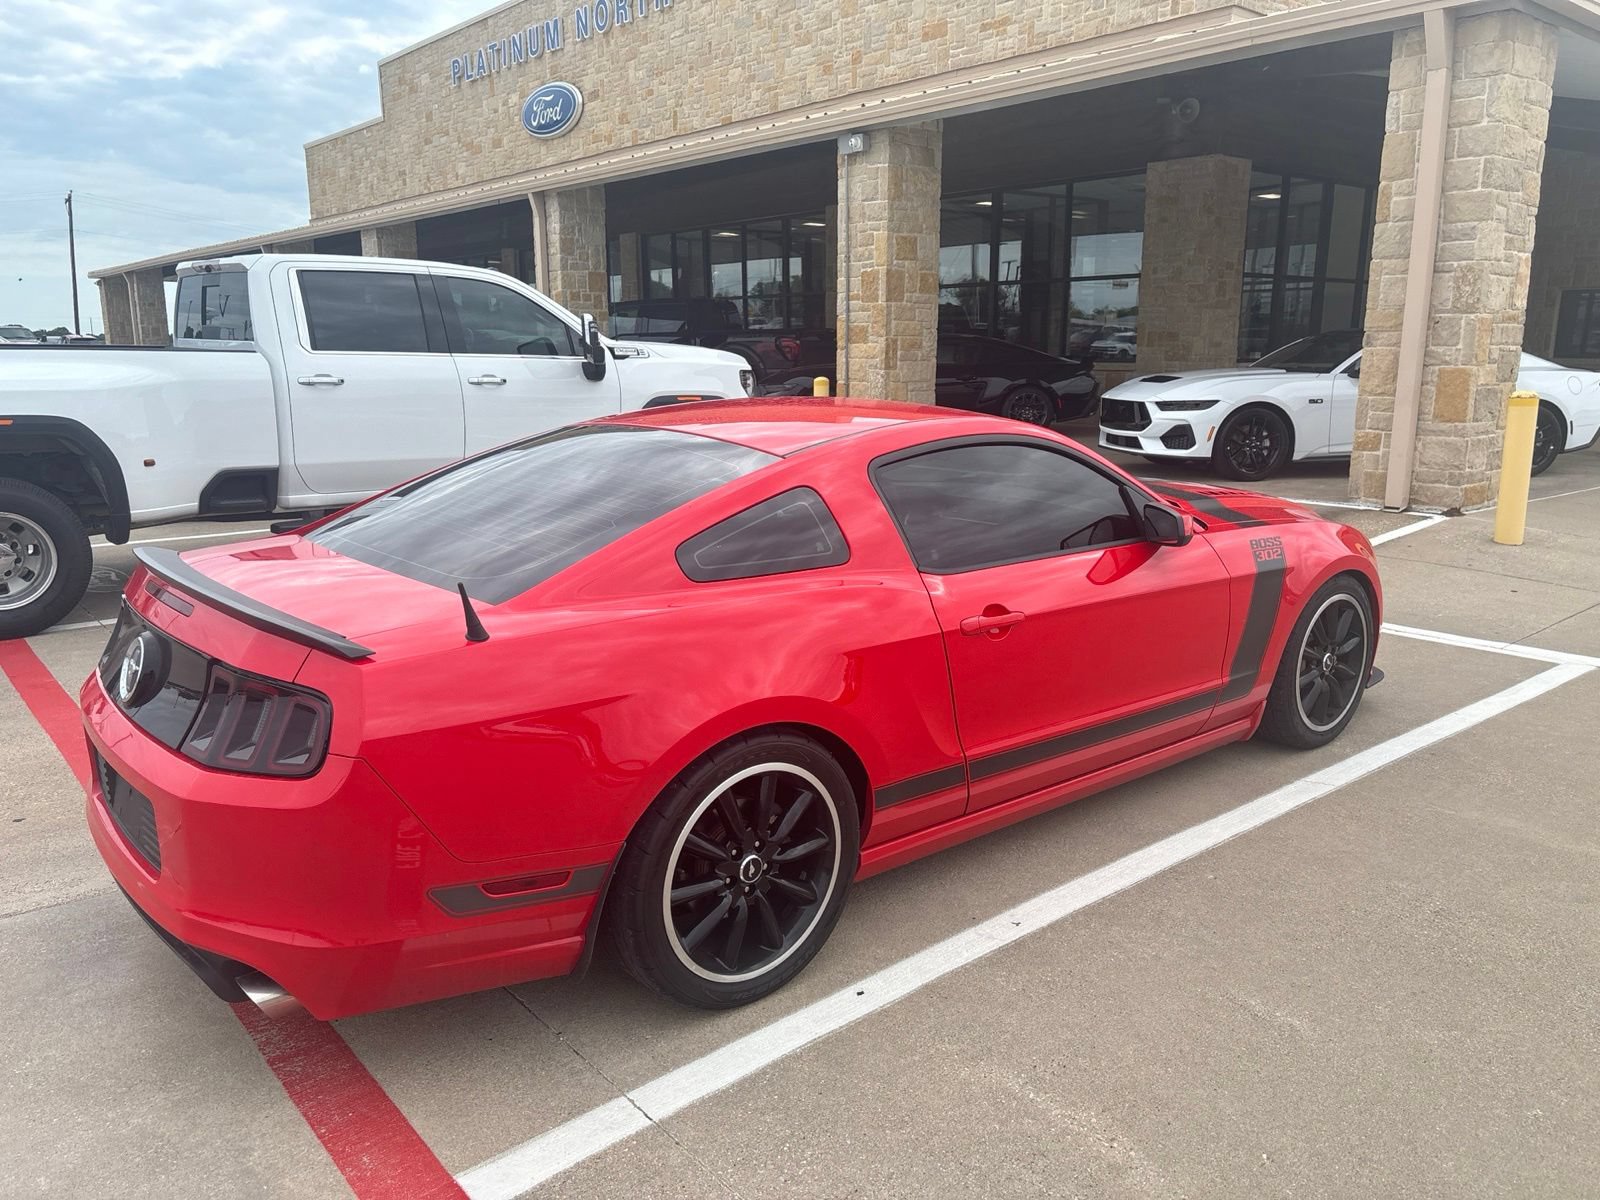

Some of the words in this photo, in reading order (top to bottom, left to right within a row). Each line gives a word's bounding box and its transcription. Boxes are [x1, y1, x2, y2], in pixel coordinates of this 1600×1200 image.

[451, 17, 562, 86] PLATINUM
[574, 0, 673, 41] NOR
[531, 94, 563, 127] Ford
[1249, 535, 1283, 550] BOSS
[1256, 547, 1283, 562] 302
